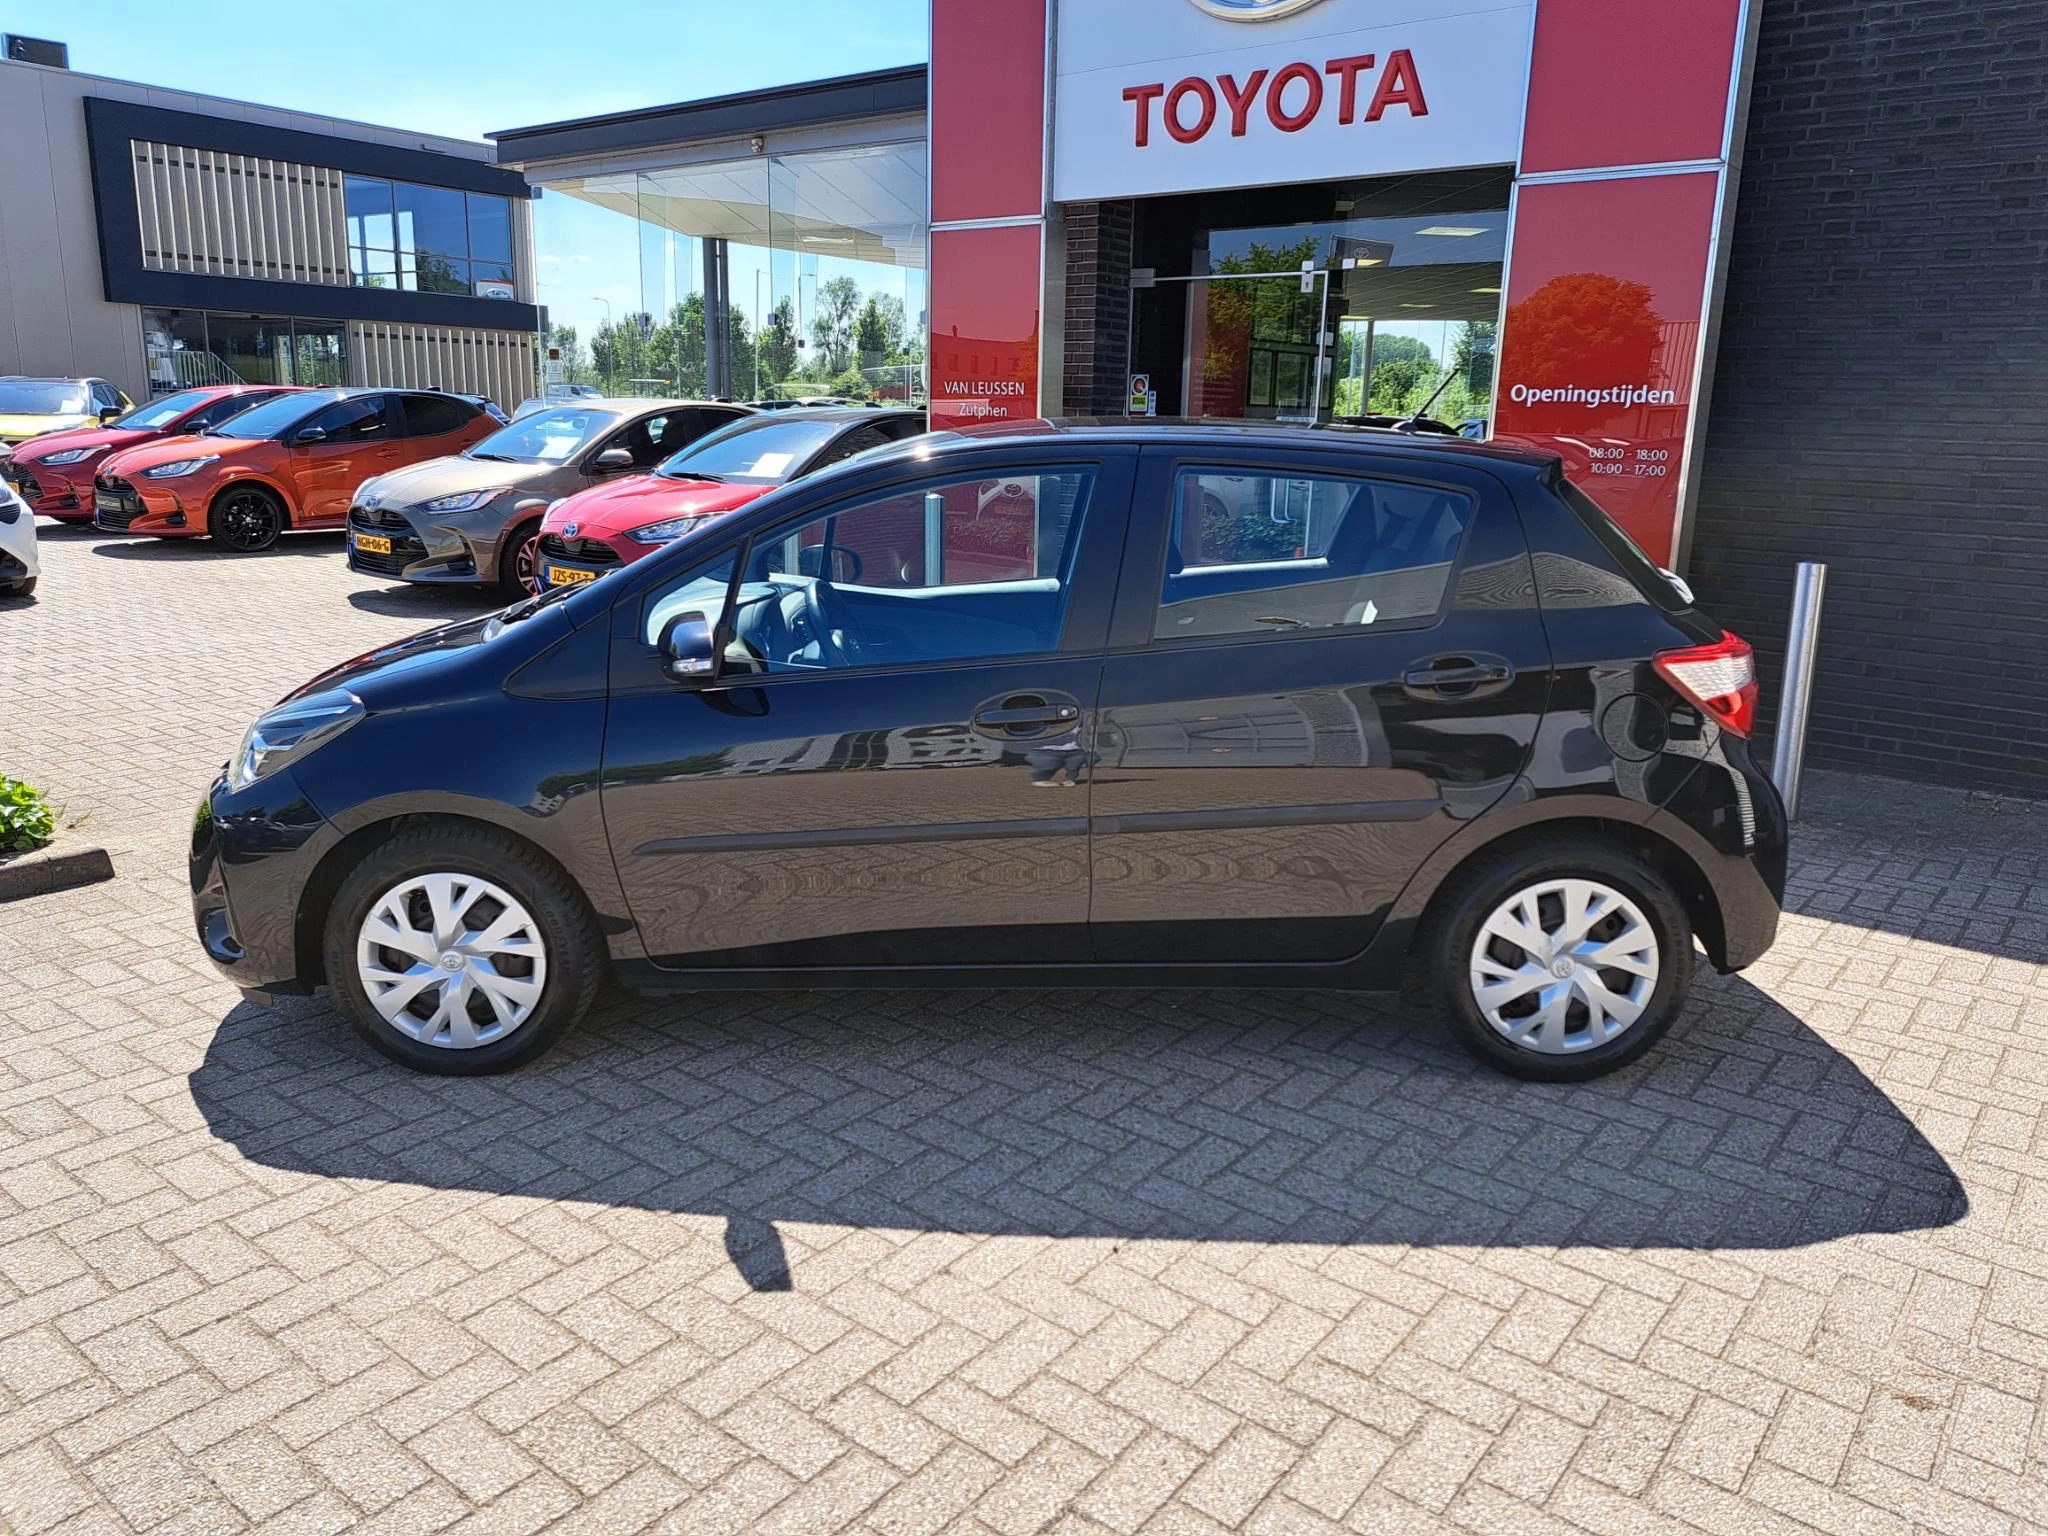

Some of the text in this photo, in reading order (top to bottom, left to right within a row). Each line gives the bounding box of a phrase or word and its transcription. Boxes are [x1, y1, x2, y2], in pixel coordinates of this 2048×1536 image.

[1122, 49, 1428, 147] TOYOTA
[944, 381, 1025, 395] VAN LEUSSEN
[1510, 384, 1675, 408] Openingstijden
[959, 403, 1008, 419] Zutphen
[1589, 447, 1624, 459] 08:00
[1635, 449, 1668, 461] 18:00
[1590, 463, 1622, 474] 10:00
[1635, 464, 1666, 476] 17:00
